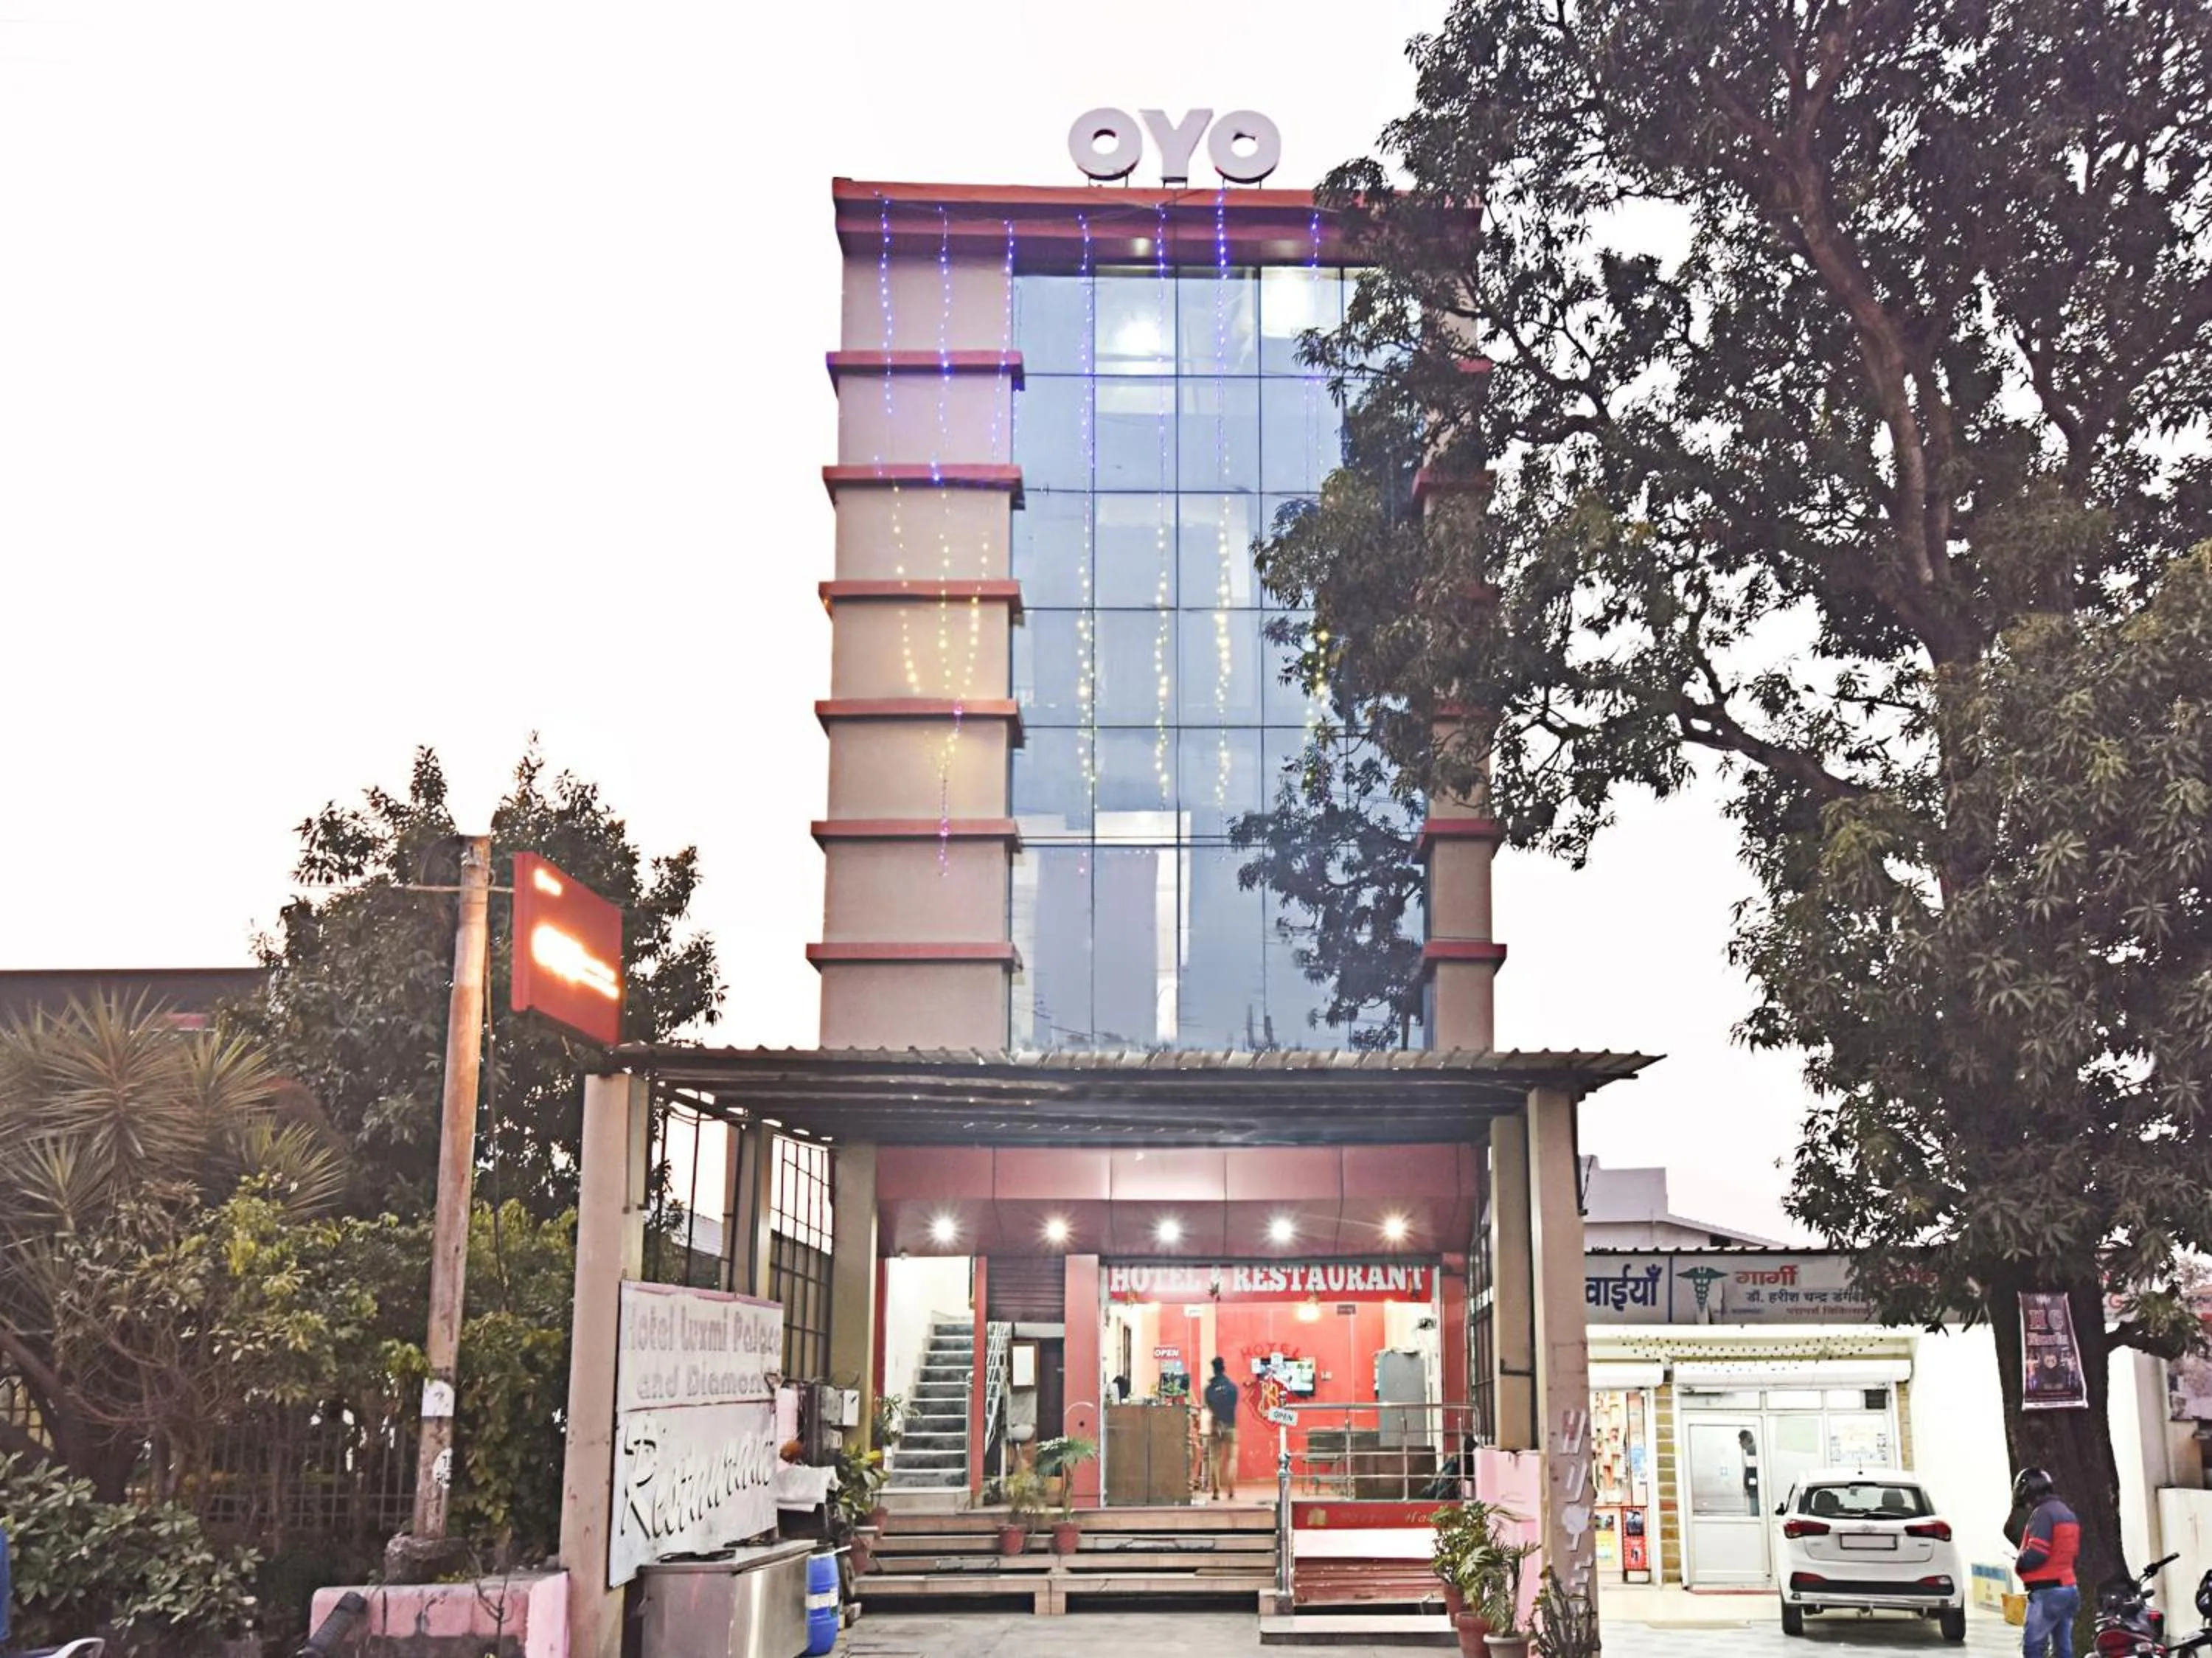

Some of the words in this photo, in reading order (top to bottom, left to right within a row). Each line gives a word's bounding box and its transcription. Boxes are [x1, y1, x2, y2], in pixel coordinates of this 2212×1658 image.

[1068, 107, 1281, 184] OYO
[1110, 1266, 1201, 1291] HOTEL
[1233, 1265, 1425, 1291] RESTAURANT
[1585, 1263, 1663, 1312] वाईयाँ
[1734, 1264, 1798, 1286] गार्गी
[1154, 1348, 1180, 1358] OPEN
[686, 1362, 774, 1397] Diamon
